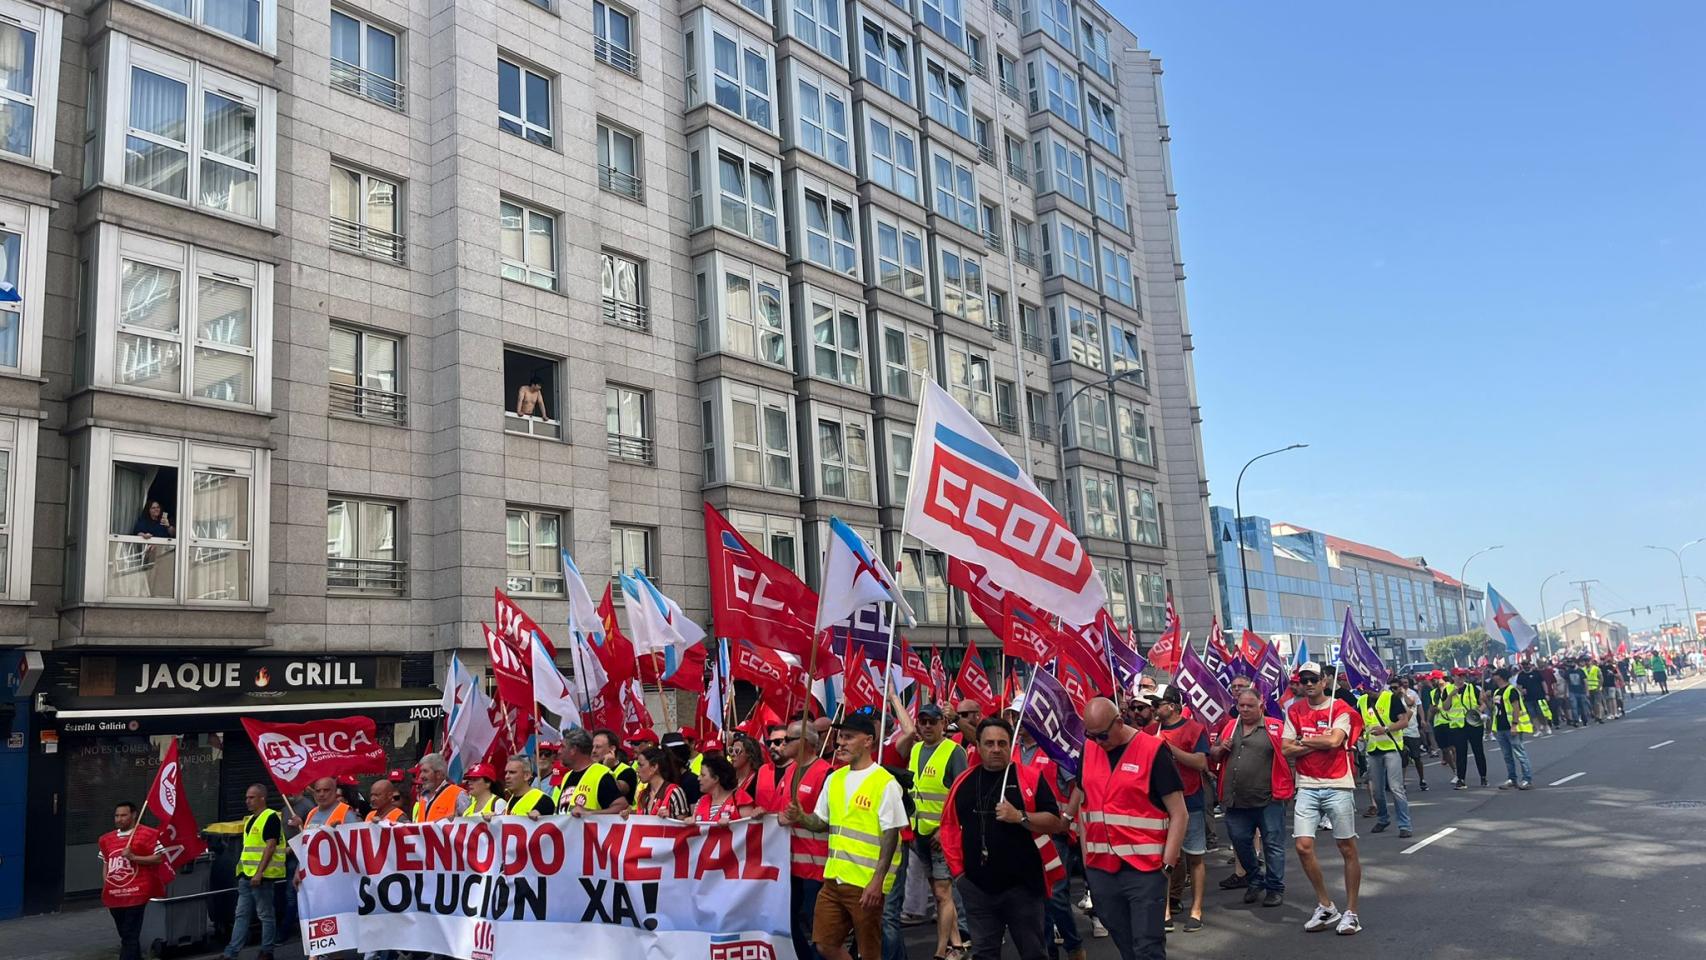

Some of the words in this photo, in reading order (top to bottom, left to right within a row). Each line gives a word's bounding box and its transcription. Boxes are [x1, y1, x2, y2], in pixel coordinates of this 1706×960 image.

[934, 465, 1083, 576] CCOO
[135, 662, 241, 693] JAQUE
[285, 661, 363, 687] GRILL
[739, 650, 781, 681] CCOO
[1176, 667, 1224, 723] COO
[65, 723, 95, 732] Estrella
[98, 721, 126, 731] Galicia
[299, 730, 371, 754] FICA
[501, 822, 565, 876] DO
[582, 822, 780, 881] METAL
[578, 877, 659, 931] XA!
[310, 937, 337, 950] FICA
